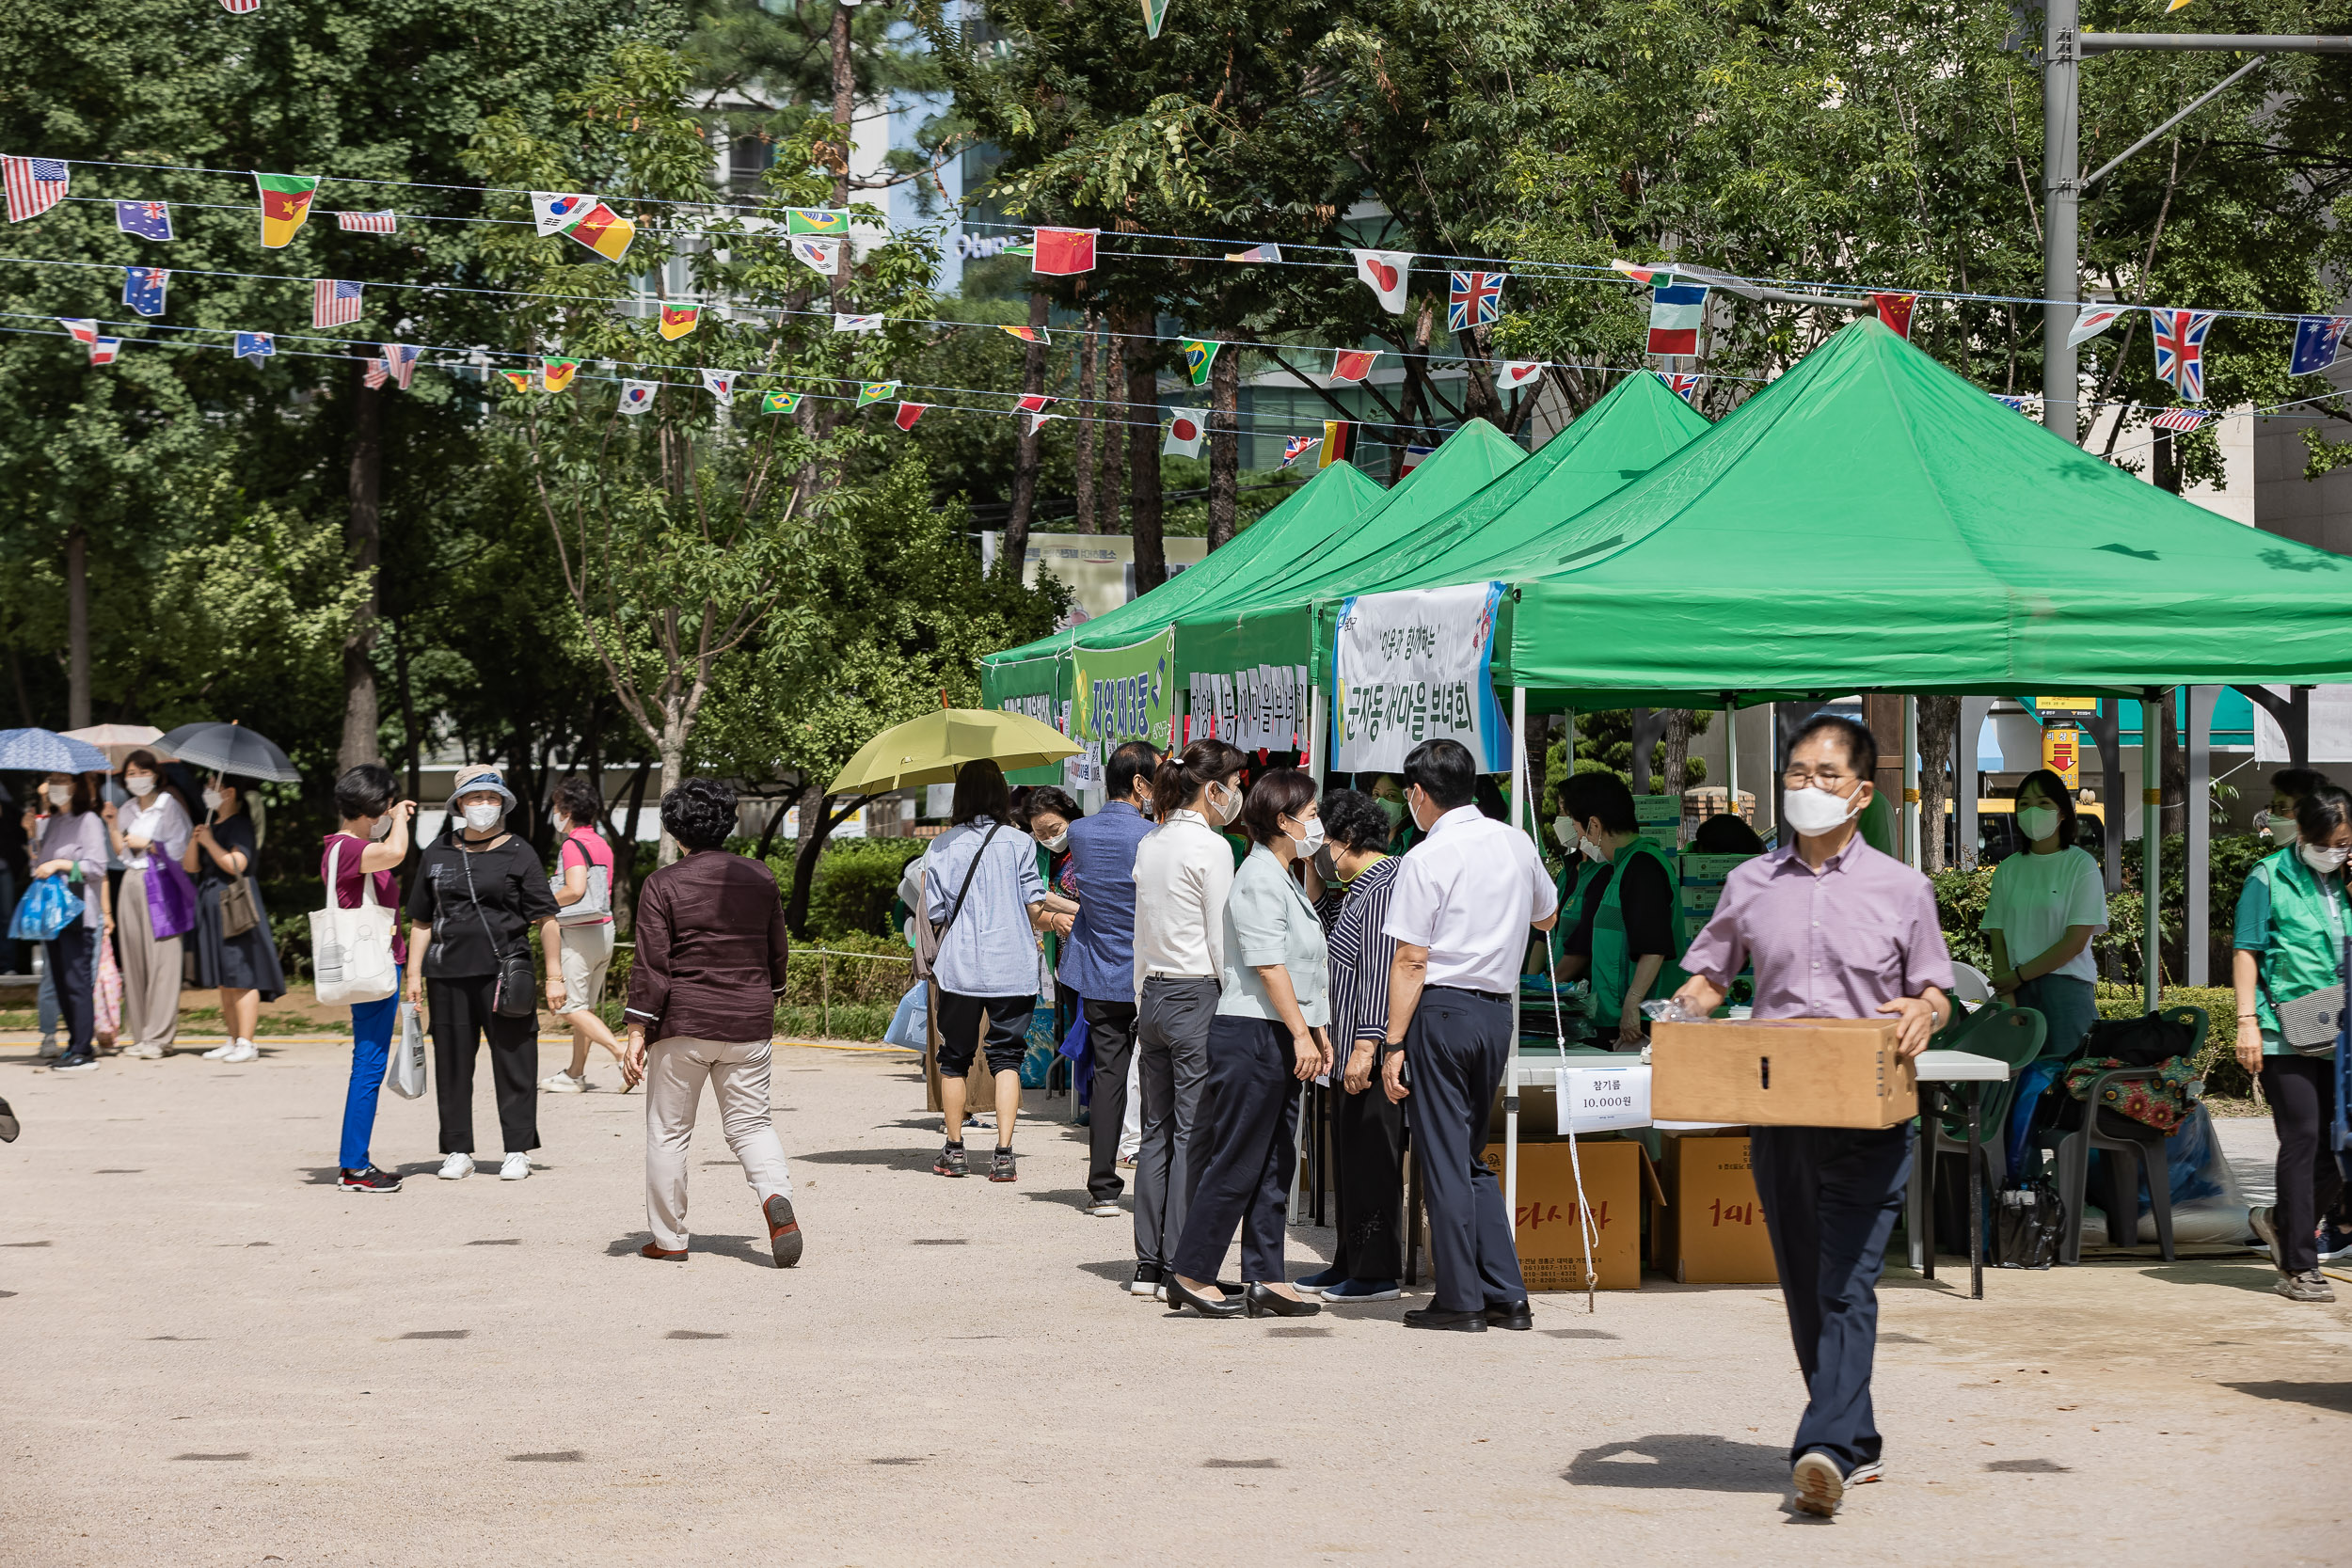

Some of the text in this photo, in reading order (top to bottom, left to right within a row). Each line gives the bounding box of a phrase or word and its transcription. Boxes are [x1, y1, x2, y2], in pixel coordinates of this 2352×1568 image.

[1347, 679, 1474, 742] 군자동 새마을 부녀회
[1593, 1079, 1622, 1091] 참기름
